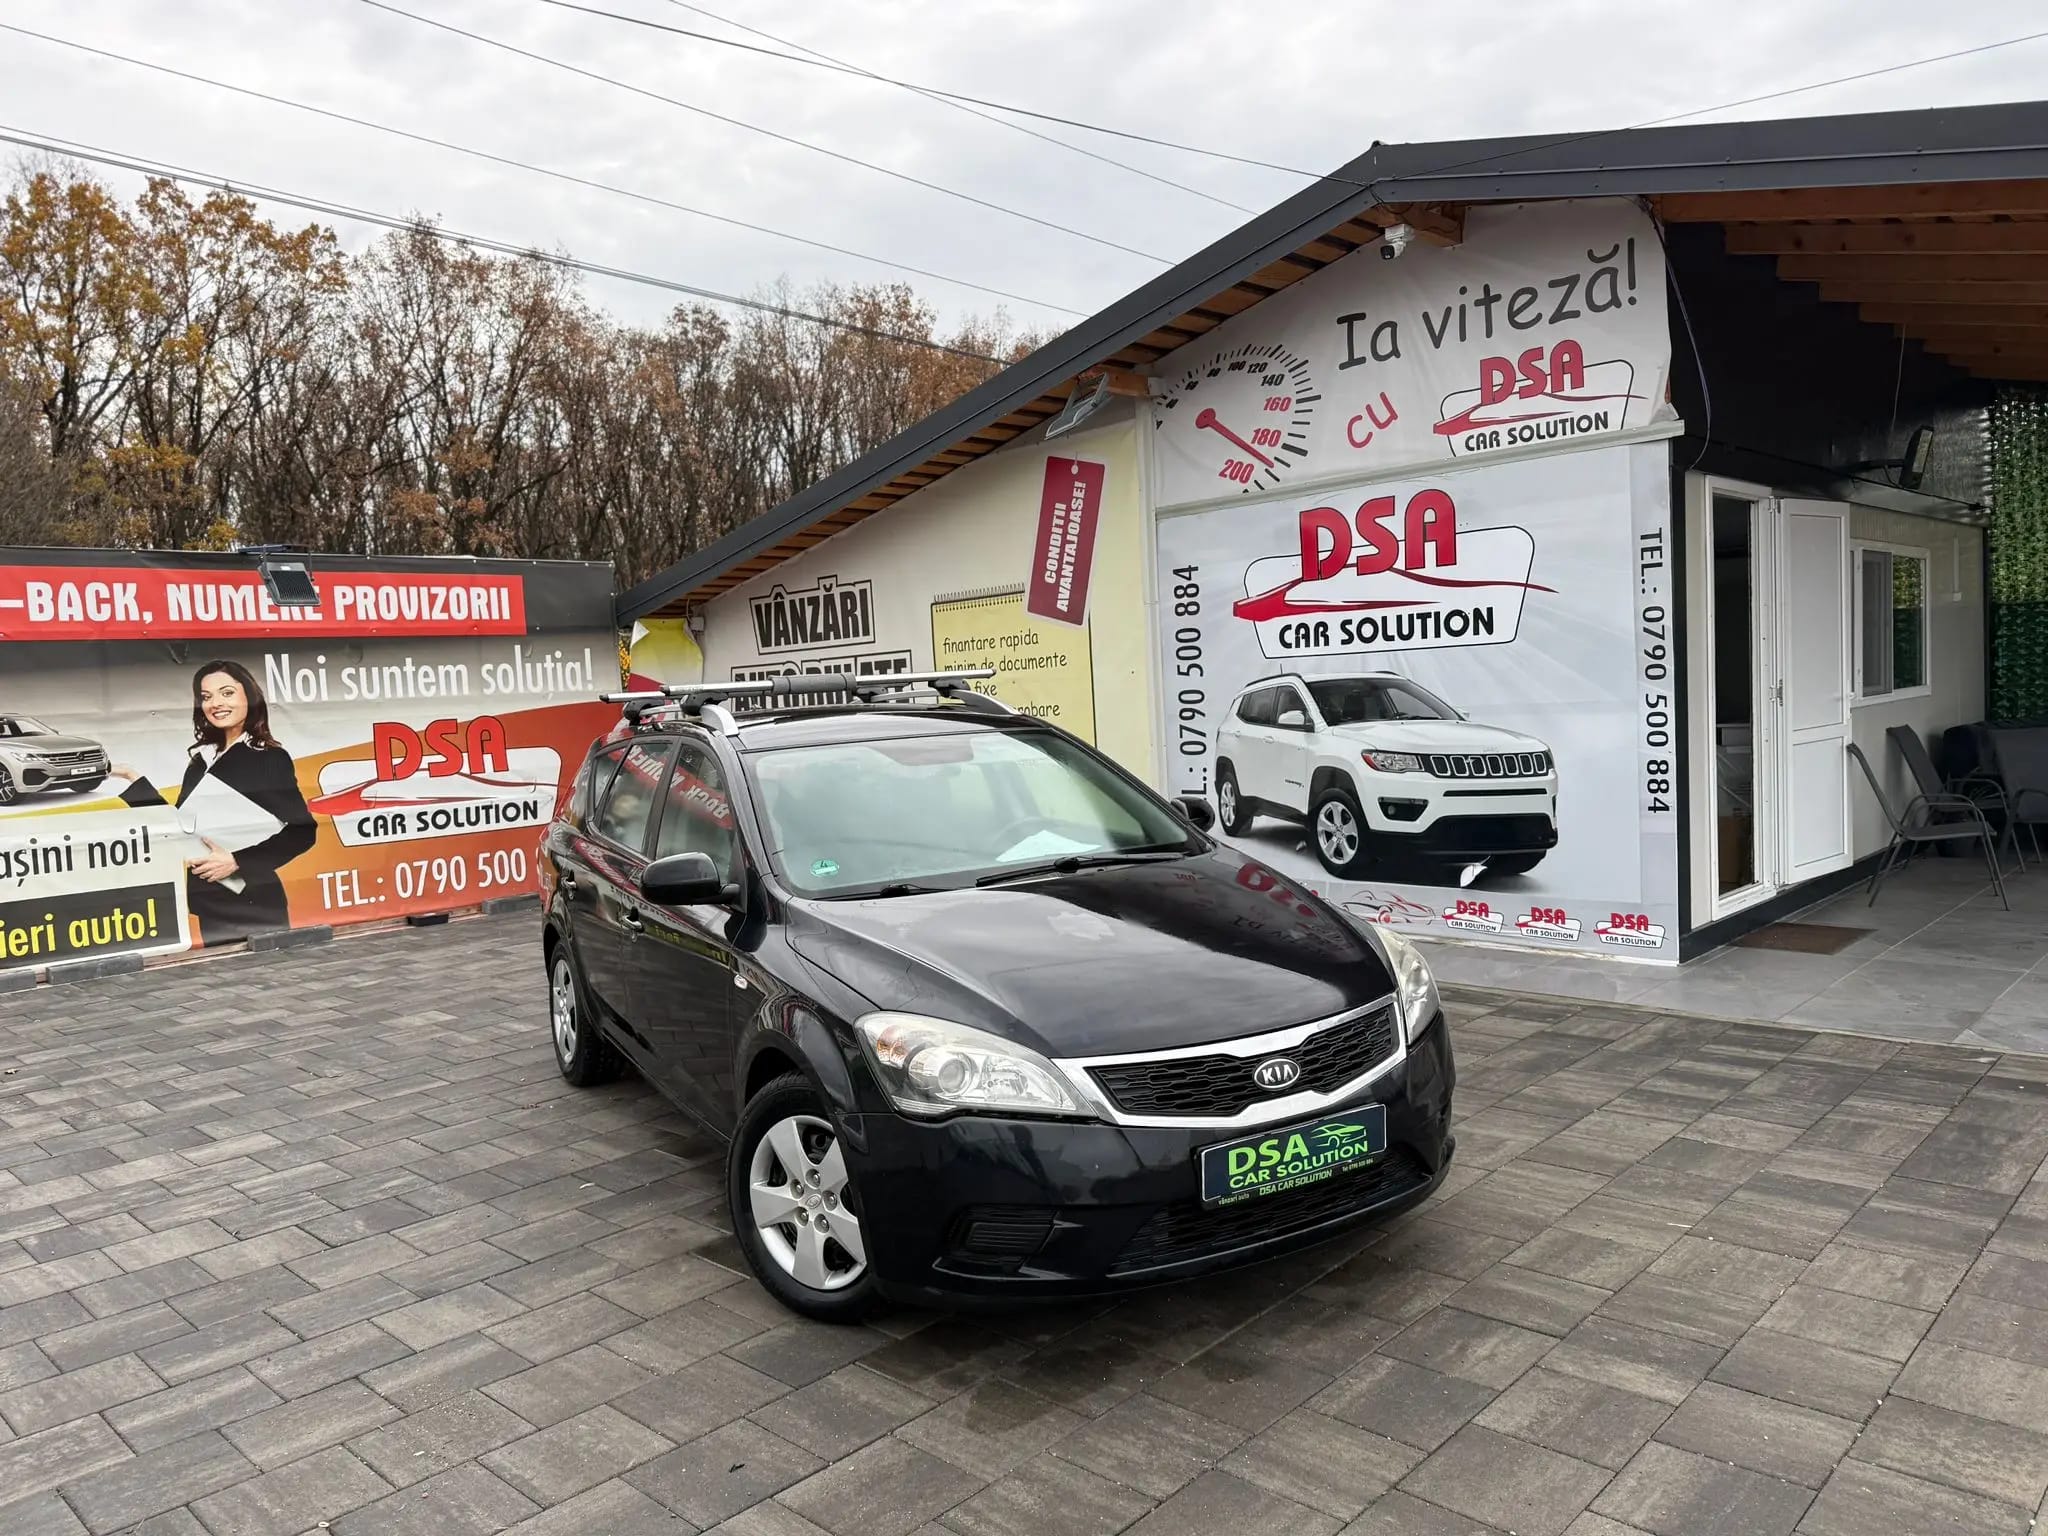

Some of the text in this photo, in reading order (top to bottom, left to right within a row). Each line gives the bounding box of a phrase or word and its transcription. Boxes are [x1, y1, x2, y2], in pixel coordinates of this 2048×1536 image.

[1337, 237, 1637, 371] Ia viteză!
[1247, 362, 1268, 374] 120
[1261, 373, 1285, 387] 140
[1480, 339, 1585, 406] DSA
[1263, 396, 1291, 412] 160
[1347, 391, 1399, 448] cu
[1251, 428, 1282, 448] 180
[1465, 411, 1609, 451] CAR SOLUTION
[1218, 458, 1255, 484] 200
[1044, 502, 1067, 584] CONDITII
[1056, 481, 1086, 613] AVANTAJOASE!
[1299, 489, 1457, 582] DSA
[334, 585, 510, 620] PROVIZORII
[1172, 565, 1200, 616] 884
[754, 583, 871, 648] VÂNZĂRI
[1279, 606, 1494, 649] CAR SOLUTION
[943, 628, 1039, 654] finantare rapida
[999, 652, 1067, 671] documente
[1175, 627, 1204, 677] 500
[264, 644, 594, 702] Noi suntem soluția!
[1640, 527, 1670, 813] TEL.: 0790 500 884
[1178, 689, 1207, 756] 0790
[373, 715, 509, 782] DSA
[357, 800, 539, 838] CAR SOLUTION
[88, 825, 151, 869] noi!
[316, 869, 386, 910] TEL.:
[395, 855, 467, 899] 0790
[478, 848, 527, 888] 500
[68, 898, 158, 948] auto!
[1456, 900, 1489, 917] DSA
[1464, 922, 1496, 931] SOLUTION
[1531, 907, 1566, 925] DSA
[1611, 913, 1648, 931] DSA
[1540, 930, 1574, 939] SOLUTION
[1621, 937, 1657, 946] SOLUTION
[1262, 1064, 1294, 1084] KIA
[1228, 1133, 1310, 1176] DSA
[1230, 1140, 1368, 1189] CAR SOLUTION
[1259, 1169, 1333, 1196] DSA CAR SOLUTION
